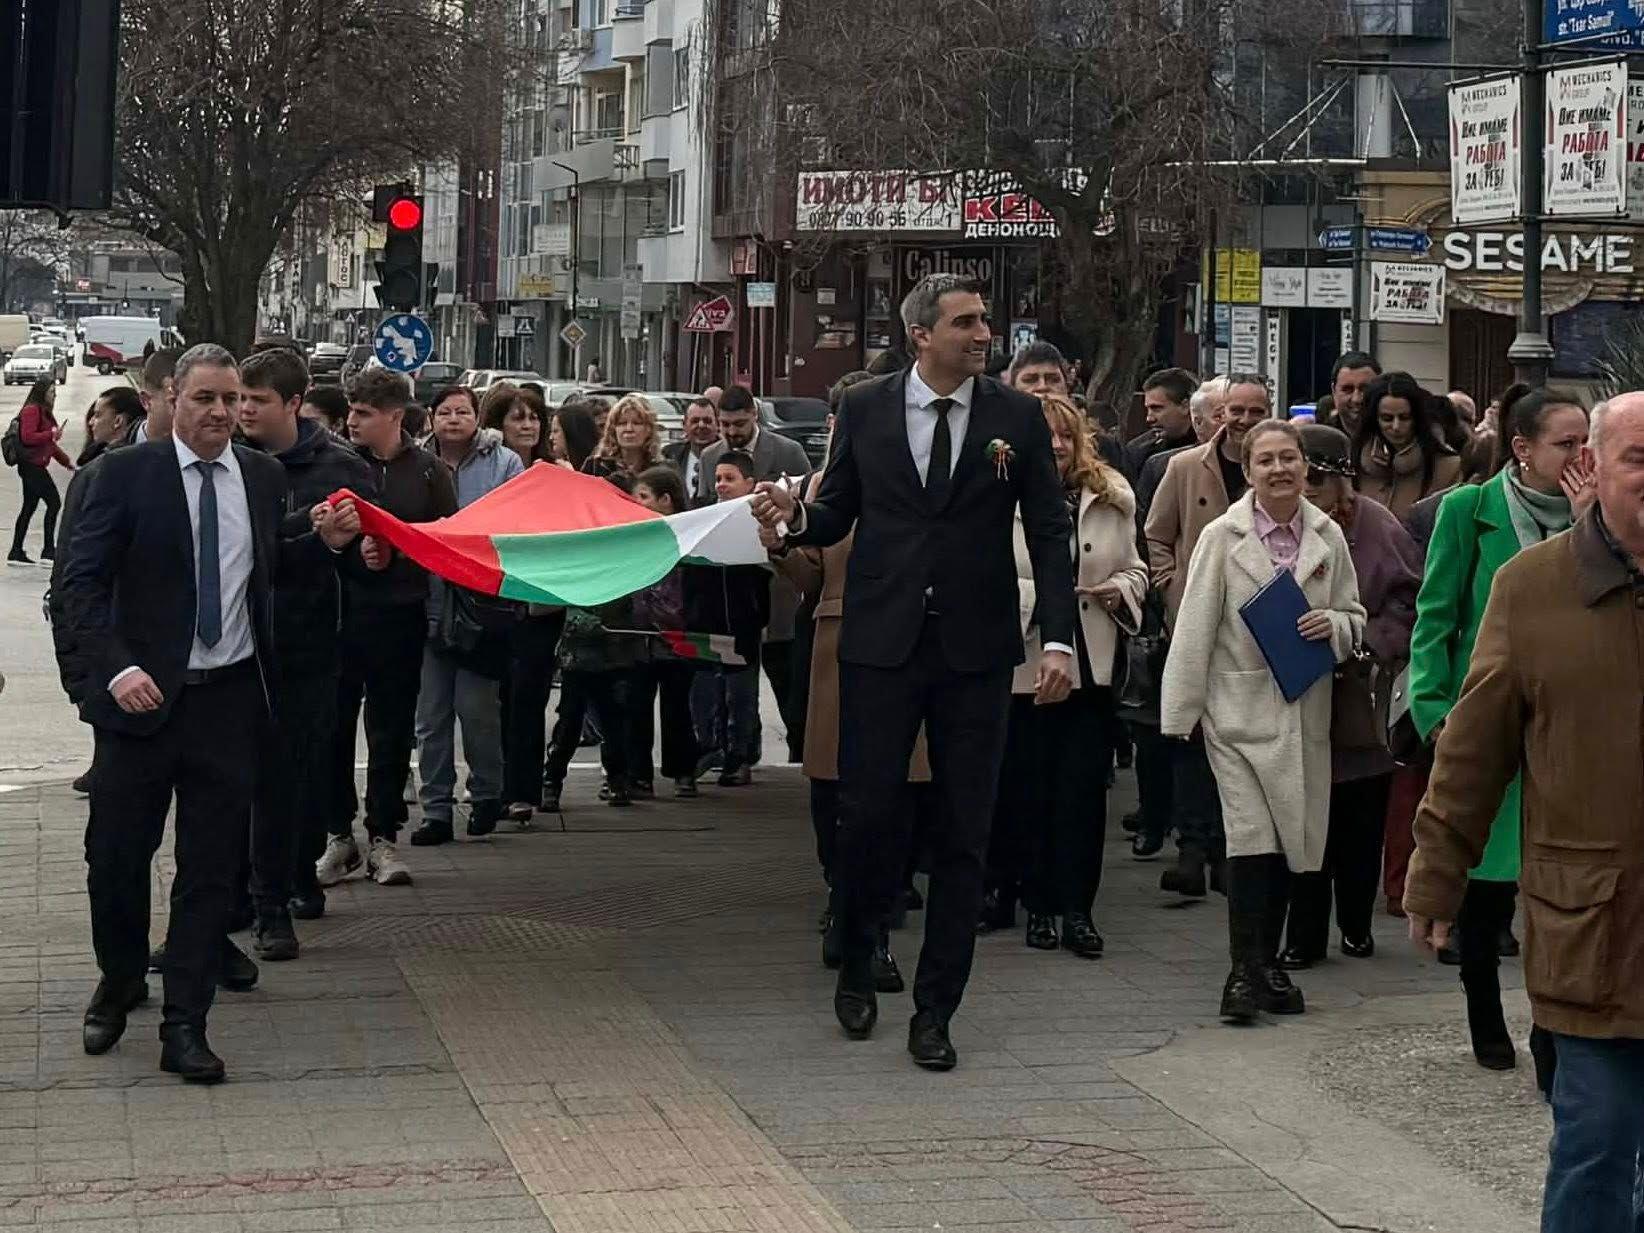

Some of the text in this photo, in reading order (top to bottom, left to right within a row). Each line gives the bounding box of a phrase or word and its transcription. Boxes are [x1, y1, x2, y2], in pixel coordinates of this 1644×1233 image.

[1466, 140, 1507, 166] РАБОТА
[1561, 130, 1609, 155] РАБОТА
[1465, 171, 1477, 191] ЗА
[1560, 161, 1574, 182] ЗА
[1443, 231, 1634, 273] SESAME
